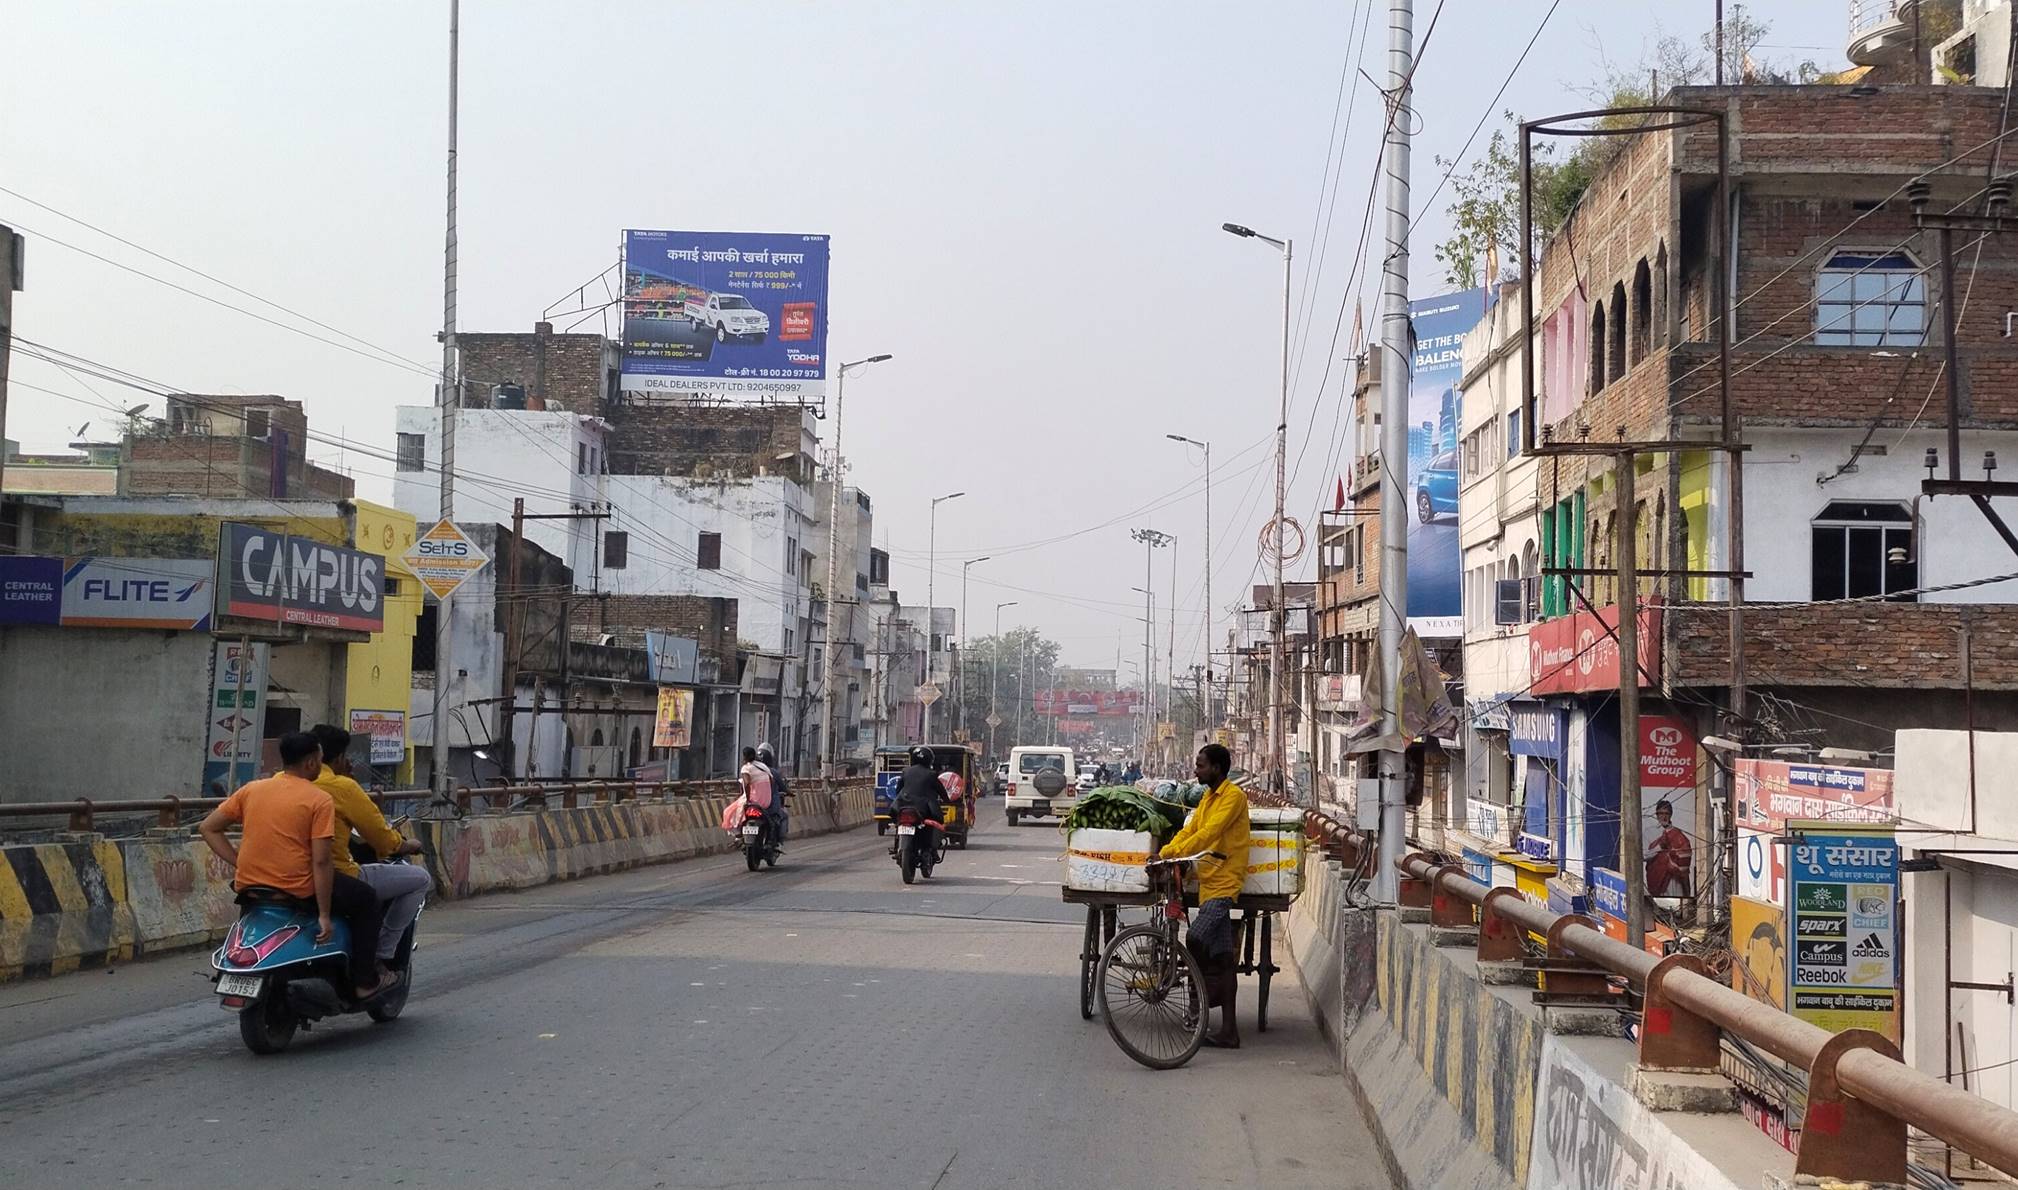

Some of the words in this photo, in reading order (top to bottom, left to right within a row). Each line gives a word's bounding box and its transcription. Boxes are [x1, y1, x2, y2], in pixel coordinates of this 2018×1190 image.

[667, 246, 699, 263] कमाई
[702, 248, 740, 263] आपकी
[742, 248, 769, 264] खर्चा
[771, 253, 804, 266] हमारा
[1418, 309, 1438, 317] MARUTI
[1439, 304, 1460, 313] SUZUKI
[1417, 338, 1434, 351] GET
[1435, 335, 1453, 348] THE
[1415, 348, 1463, 367] BALEN
[770, 369, 780, 377] 00
[782, 369, 791, 377] 20
[793, 370, 802, 378] 97
[804, 370, 819, 378] 979
[1430, 363, 1449, 372] BOLDER
[644, 379, 668, 388] IDEAL
[670, 380, 708, 390] DEALERS
[710, 382, 726, 390] PVT
[747, 383, 801, 392] 9204650997
[242, 535, 377, 612] CAMPUS
[5, 581, 54, 591] CENTRAL
[84, 580, 169, 602] FLITE
[5, 592, 53, 601] LEATHER
[286, 610, 312, 623] CENTRAL
[313, 613, 339, 626] LEATHER
[1512, 713, 1555, 742] SAMSUNG
[1655, 746, 1678, 756] The
[1640, 755, 1691, 766] Muthoot
[1647, 765, 1685, 778] Group
[1769, 793, 1803, 817] भगवान
[1804, 797, 1824, 819] दास
[1796, 845, 1825, 875] शू
[1825, 839, 1894, 867] संसार
[1857, 886, 1885, 896] RED
[1799, 898, 1846, 910] WOODLAND
[1799, 919, 1846, 933] sparx
[1853, 918, 1889, 929] CHIEF
[1800, 951, 1843, 963] Campus
[1852, 948, 1890, 958] adidas
[1797, 968, 1847, 983] Reebok
[1873, 997, 1893, 1011] दुकान
